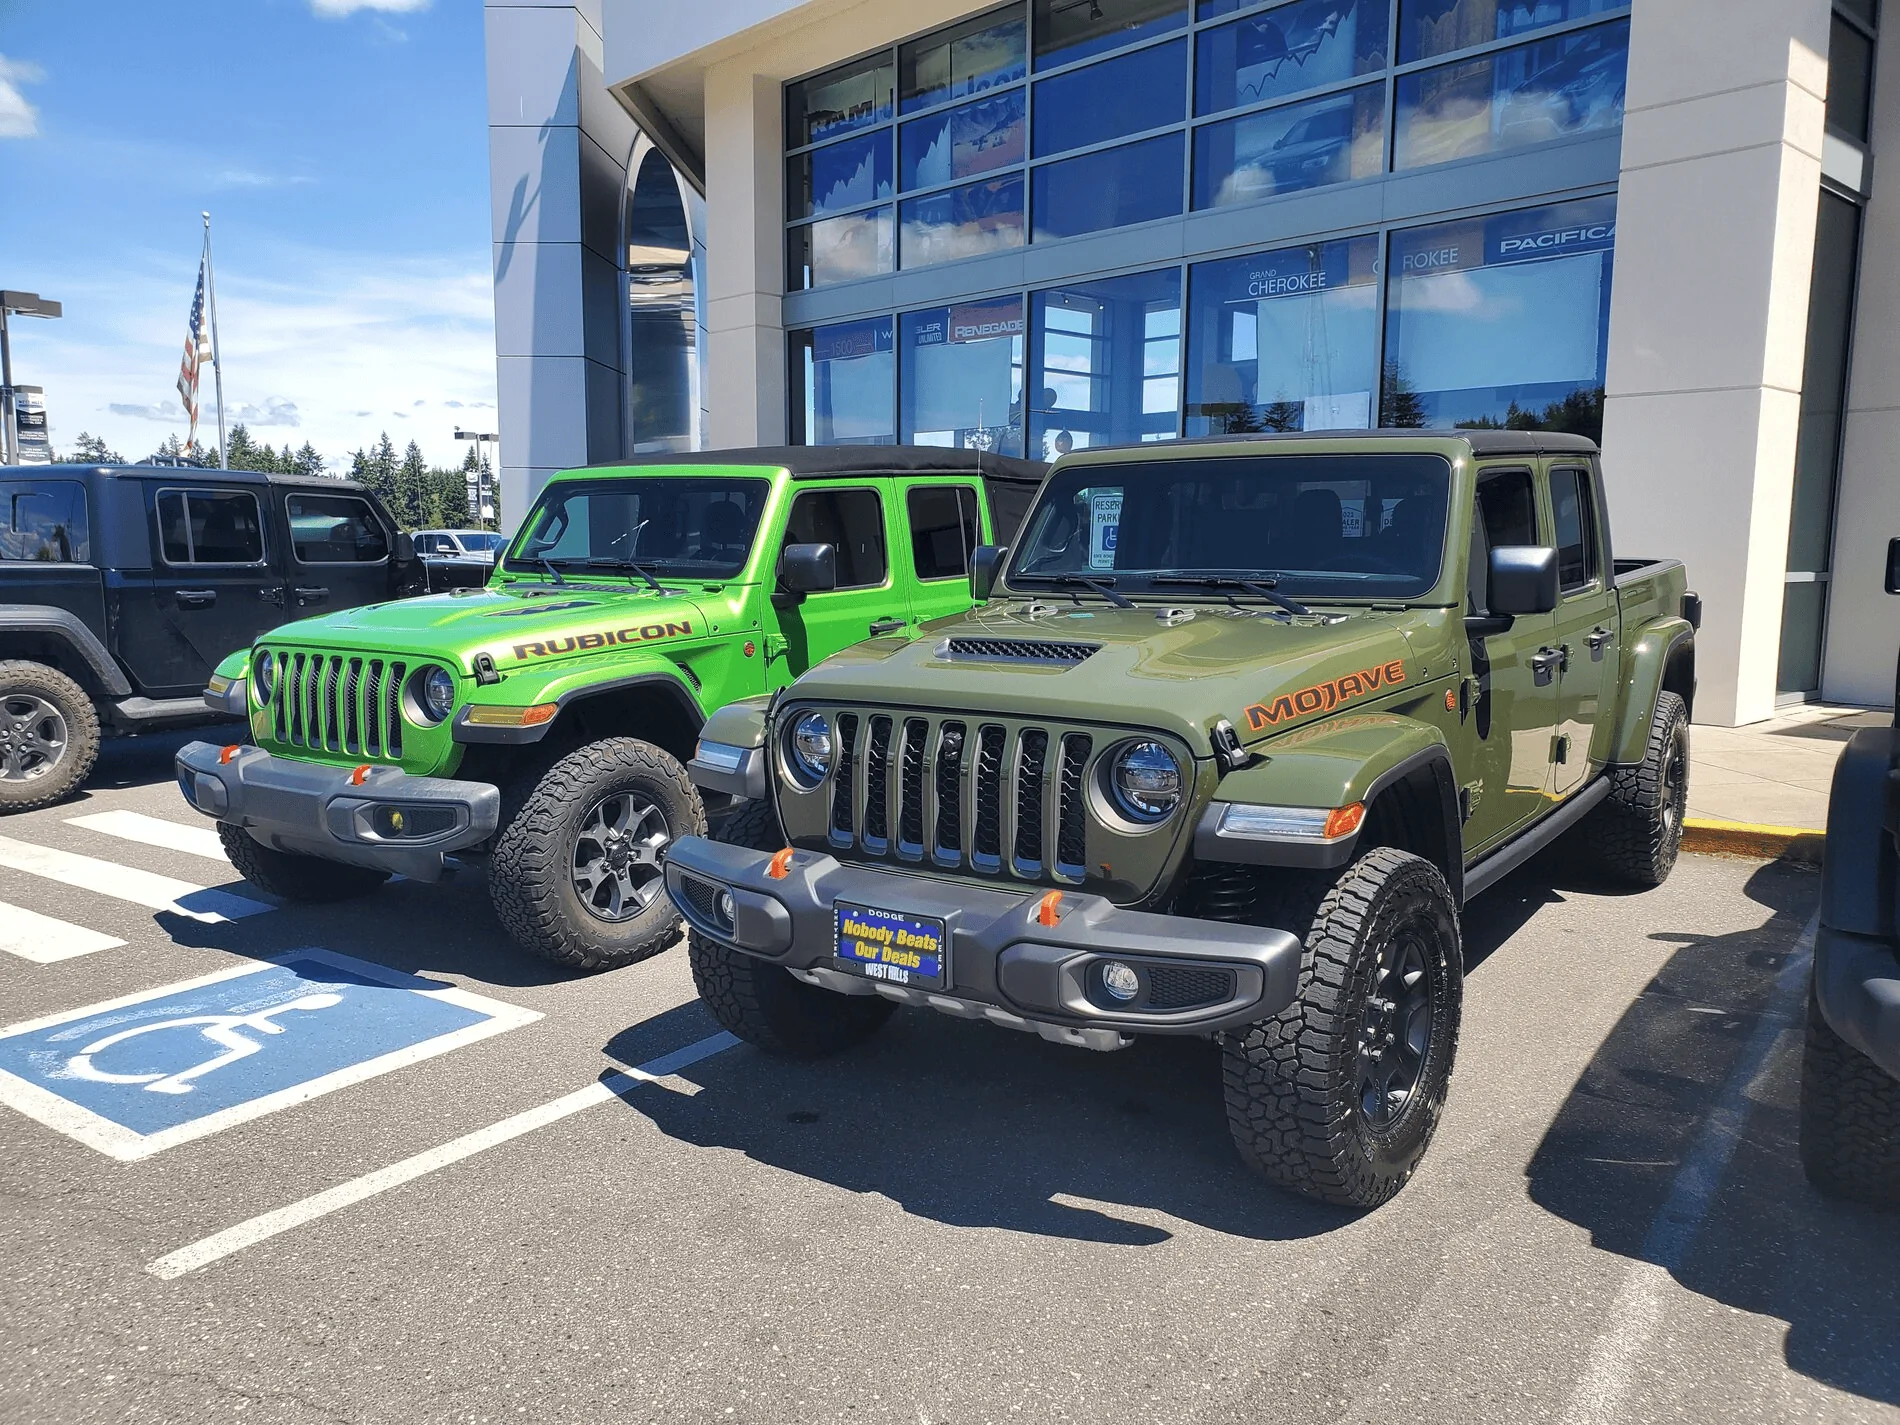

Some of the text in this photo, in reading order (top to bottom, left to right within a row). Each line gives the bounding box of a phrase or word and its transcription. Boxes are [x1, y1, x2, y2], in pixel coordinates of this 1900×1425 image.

[1248, 271, 1326, 296] CHEROKEE
[1249, 269, 1277, 280] GRAND
[955, 319, 1023, 338] RENEGADE
[1095, 500, 1121, 511] RESER
[512, 620, 693, 661] RUBICON
[1244, 659, 1406, 731] MOJAVE
[868, 908, 905, 922] DODGE
[843, 918, 938, 951] Nobody Beats
[855, 940, 921, 968] Our Deals
[865, 962, 909, 984] WEST HILLS
